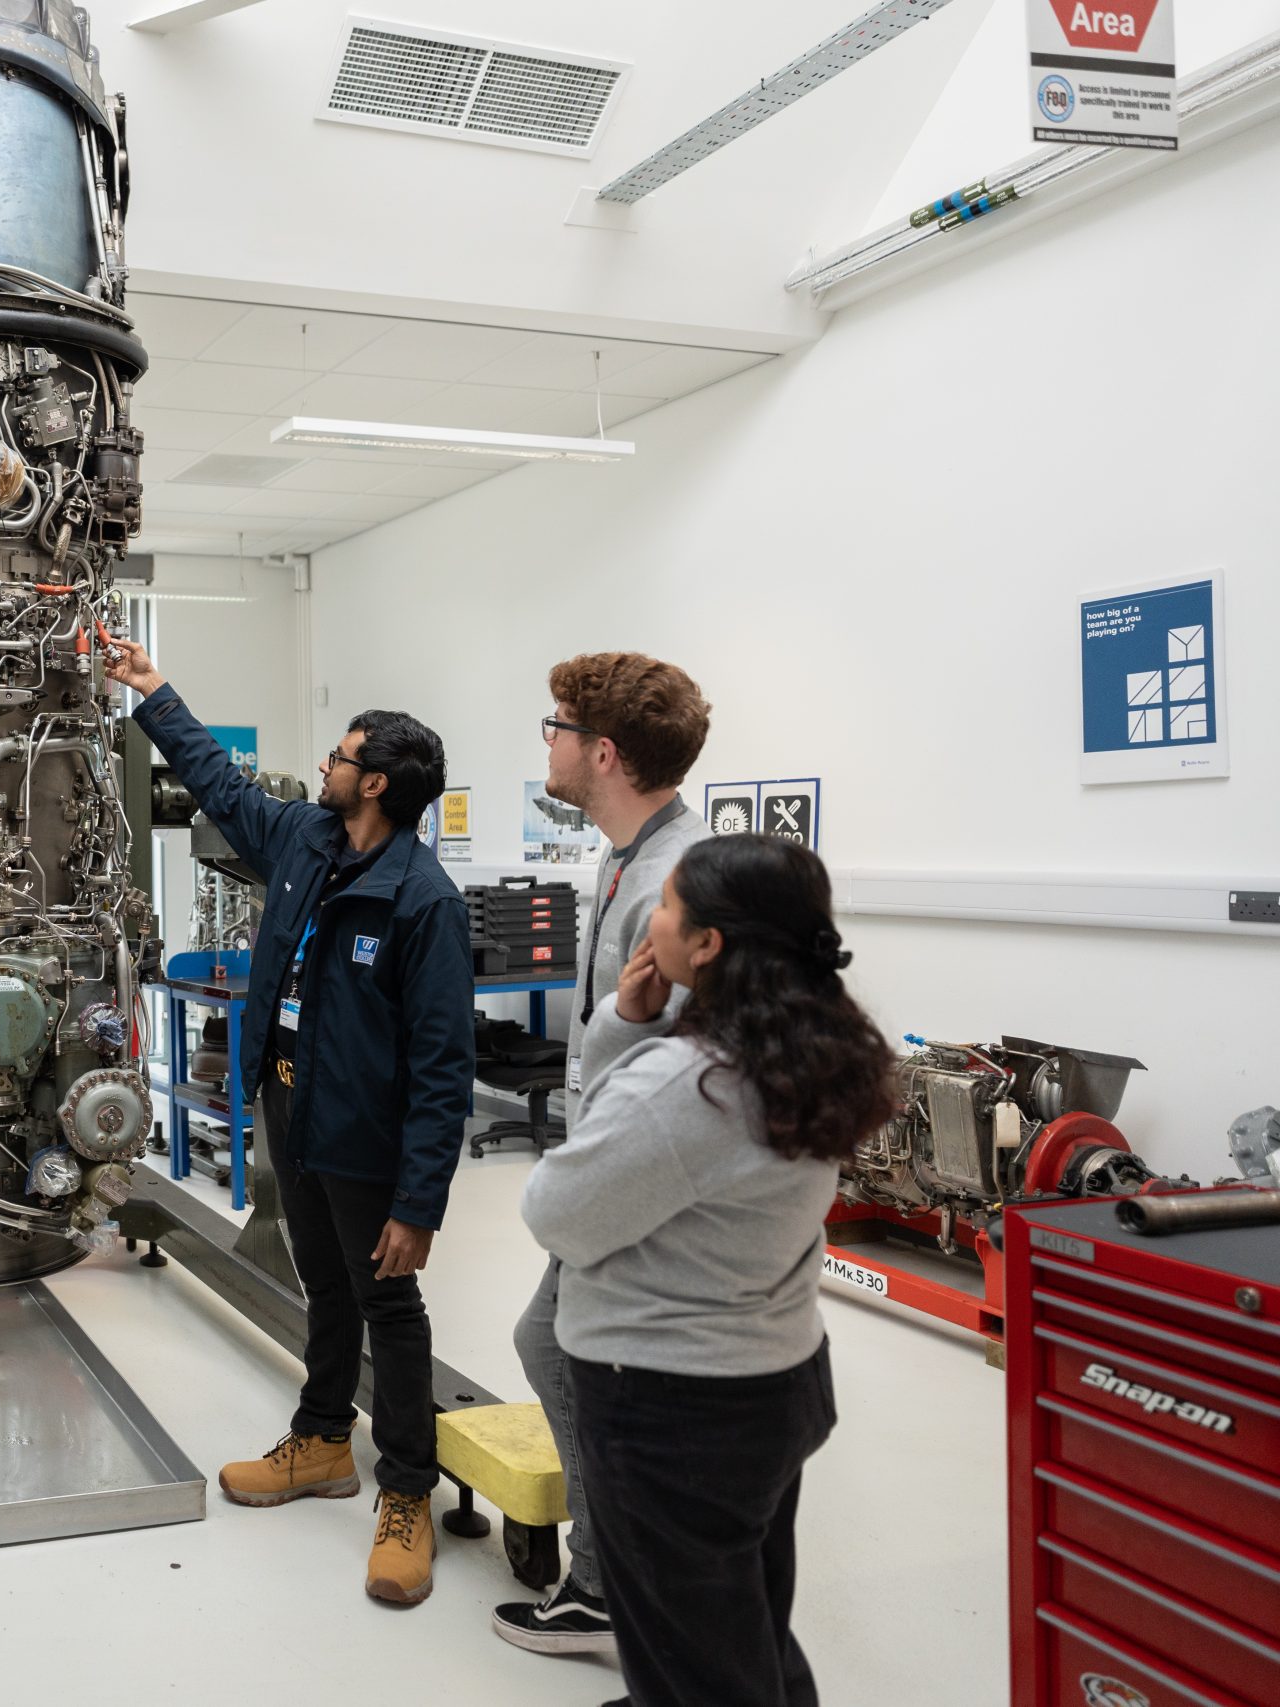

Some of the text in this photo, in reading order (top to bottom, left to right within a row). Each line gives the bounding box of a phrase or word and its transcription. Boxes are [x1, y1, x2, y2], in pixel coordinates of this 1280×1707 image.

[1070, 2, 1136, 37] Area
[1086, 612, 1105, 621] how
[1107, 608, 1121, 617] big
[1122, 605, 1132, 614] of
[1086, 615, 1141, 629] team are you
[1086, 623, 1136, 640] playing on?
[231, 745, 256, 766] be
[448, 797, 463, 807] FOD
[444, 811, 467, 820] Control
[448, 823, 463, 833] Area
[722, 818, 740, 832] OE
[1079, 1362, 1233, 1434] Snap-on
